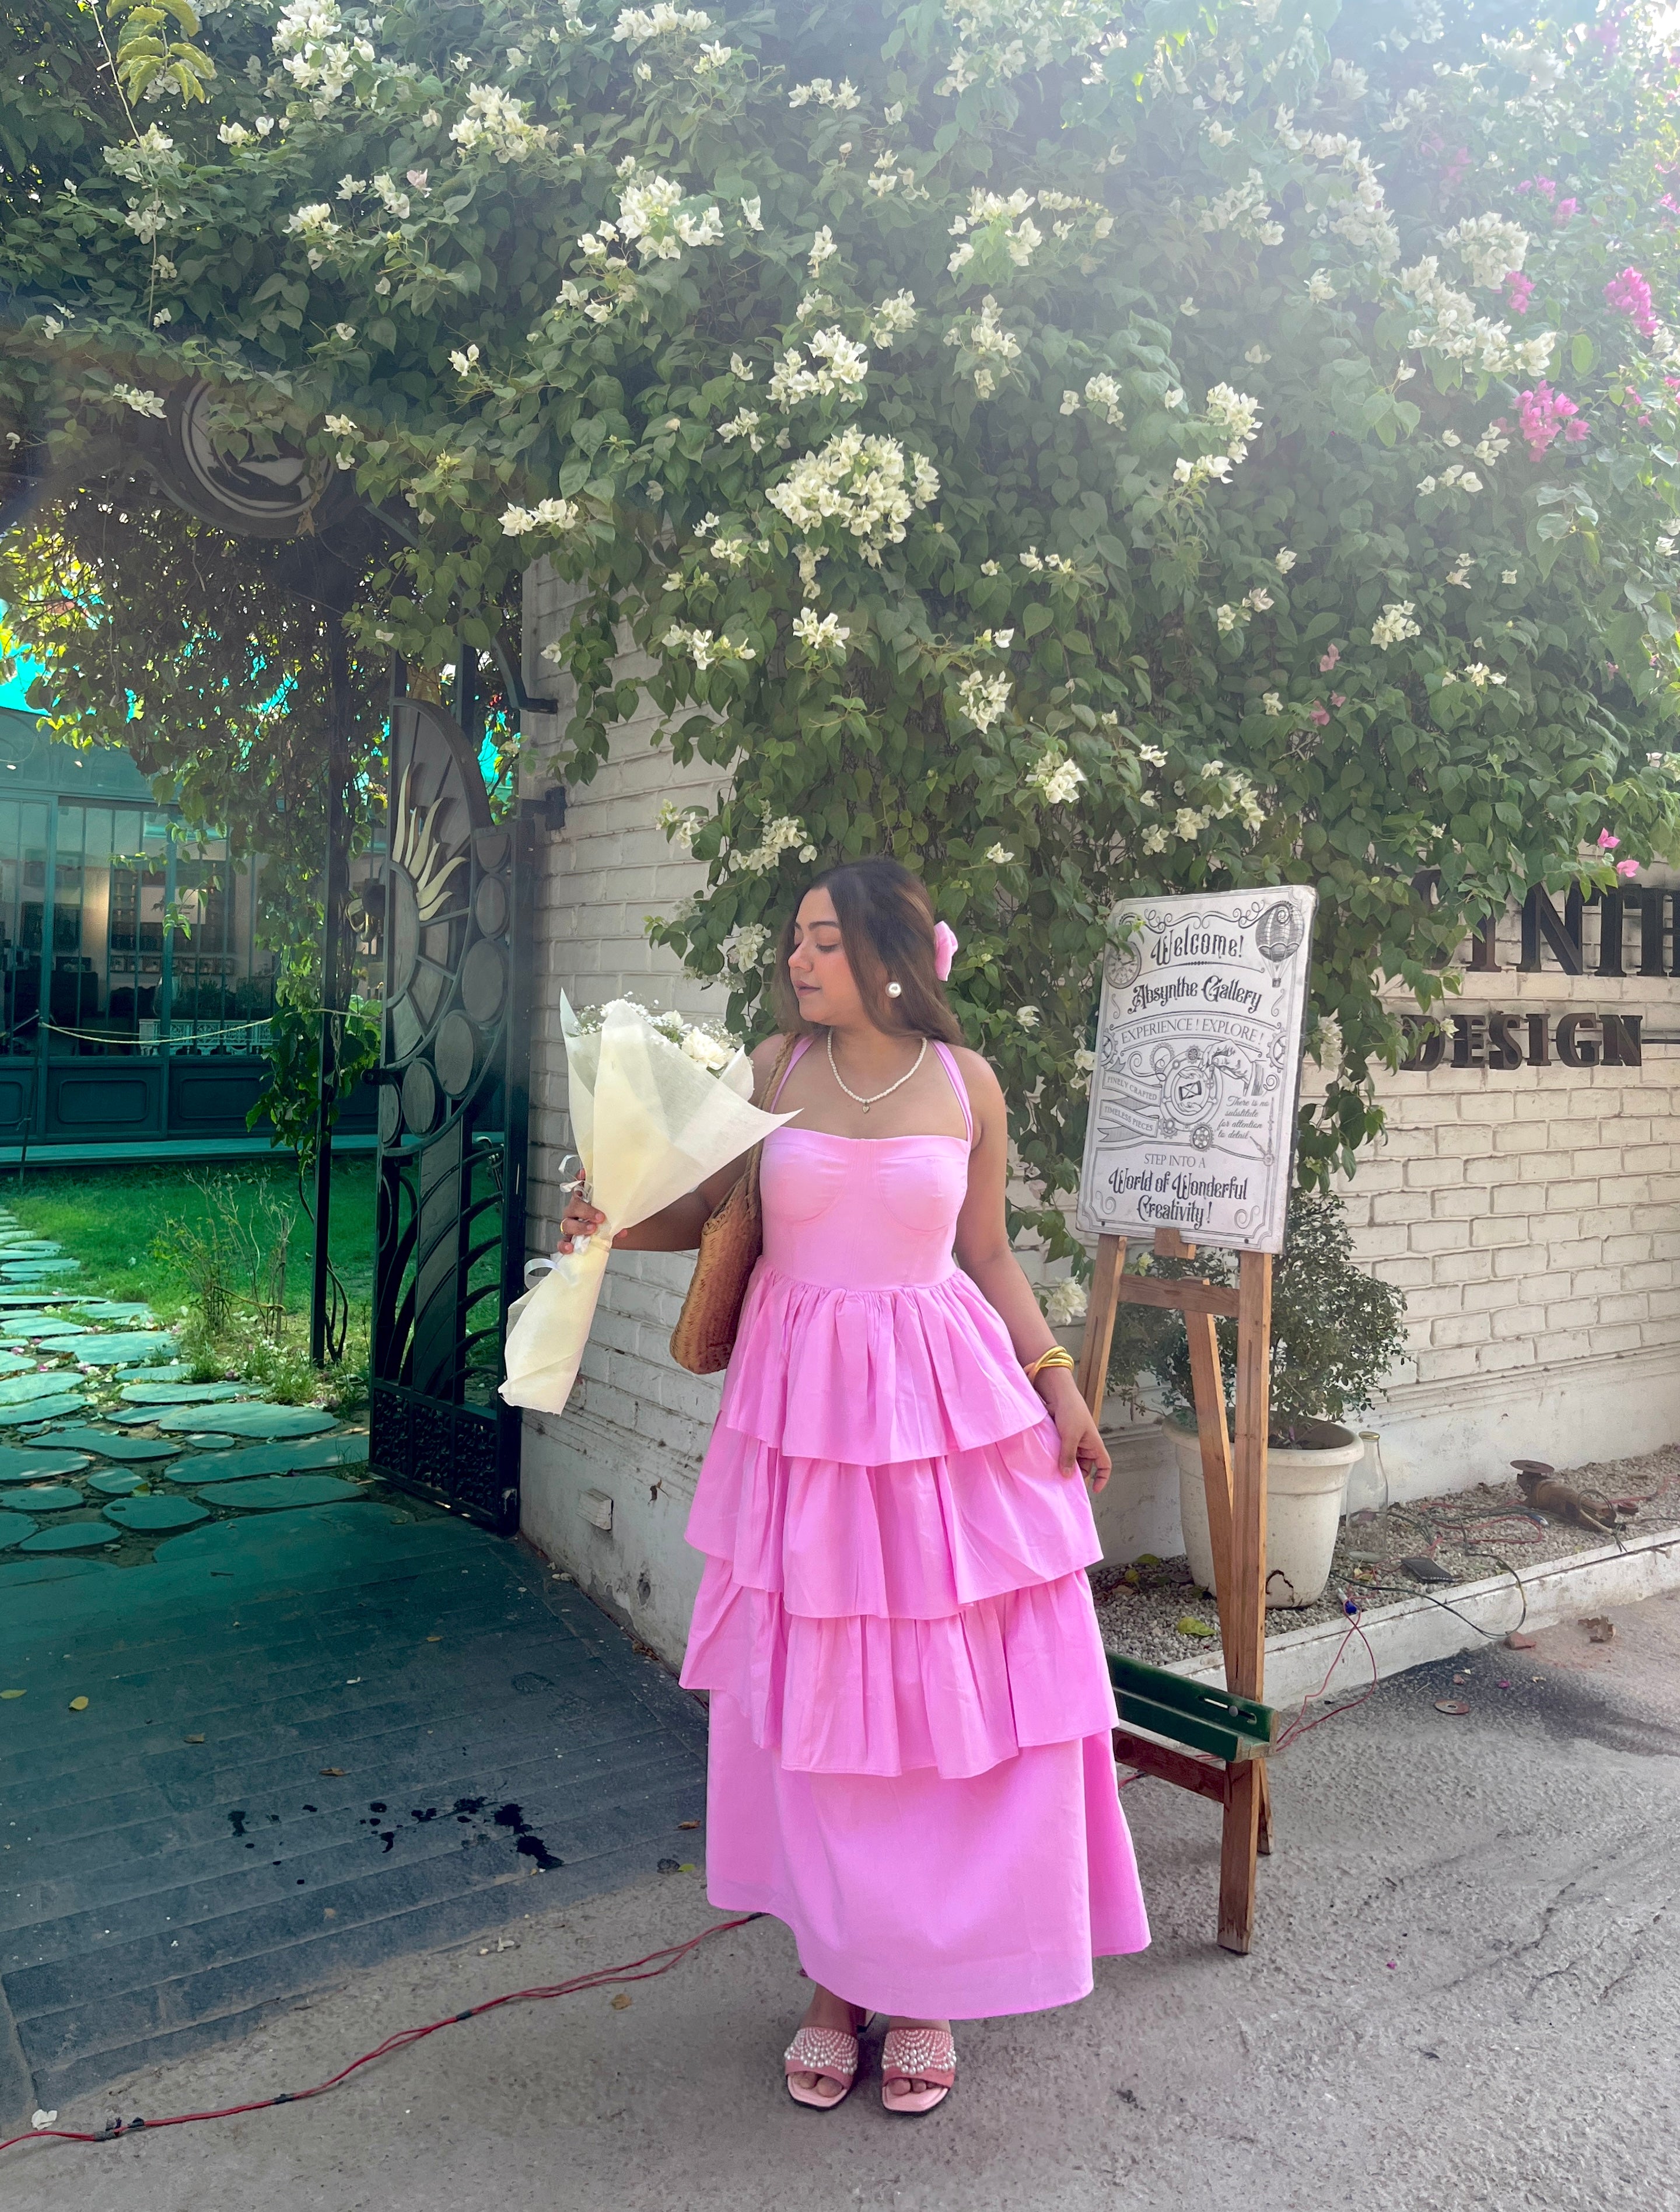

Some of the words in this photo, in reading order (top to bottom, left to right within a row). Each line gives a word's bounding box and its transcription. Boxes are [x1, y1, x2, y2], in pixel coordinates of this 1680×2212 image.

[1150, 924, 1244, 966] Welcome!
[1127, 976, 1198, 1014] Absynthe
[1201, 975, 1262, 1014] Gallery
[1399, 1013, 1643, 1071] DESIGN
[1107, 1076, 1128, 1088] FINELY
[1129, 1084, 1157, 1100] CRAFTED
[1226, 1095, 1250, 1106] There
[1104, 1106, 1131, 1123] TIMELESS
[1132, 1118, 1153, 1131] PIECES
[1216, 1119, 1229, 1131] for
[1231, 1119, 1262, 1128] attention
[1224, 1109, 1259, 1117] substitute
[1227, 1130, 1250, 1139] detail
[1143, 1153, 1167, 1166] STEP
[1169, 1155, 1196, 1167] INTO
[1198, 1157, 1206, 1168] A
[1108, 1167, 1154, 1194] World
[1155, 1170, 1171, 1193] of
[1171, 1172, 1248, 1200] Wonderful
